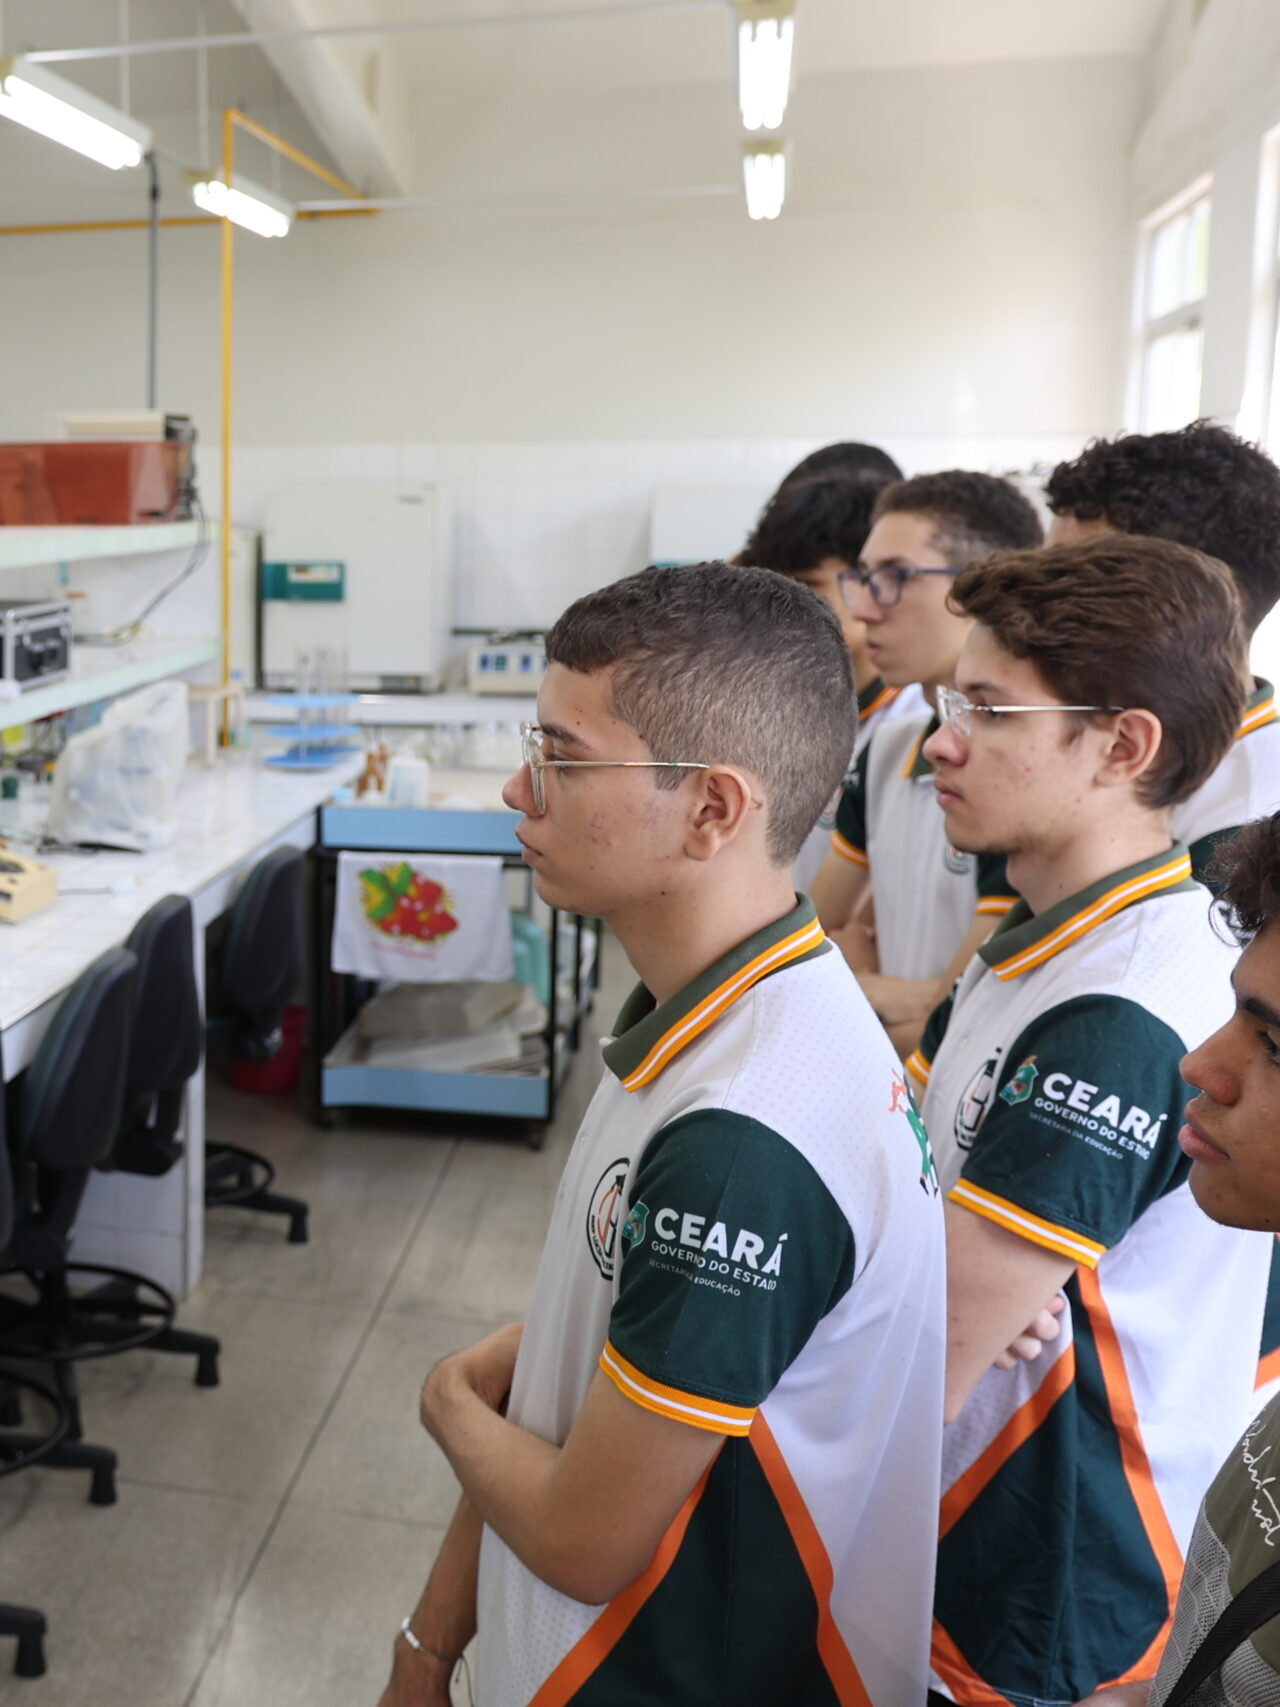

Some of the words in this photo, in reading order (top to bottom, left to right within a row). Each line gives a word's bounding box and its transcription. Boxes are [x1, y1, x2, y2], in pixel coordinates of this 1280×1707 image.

[1034, 1097, 1099, 1130] GOVERNO
[1099, 1125, 1118, 1141] DO
[1042, 1072, 1168, 1149] CEARÁ
[651, 1240, 706, 1268] GOVERNO
[708, 1260, 730, 1275] DO
[654, 1207, 788, 1277] CEARÁ
[694, 1276, 741, 1297] EDUCAÇÃO
